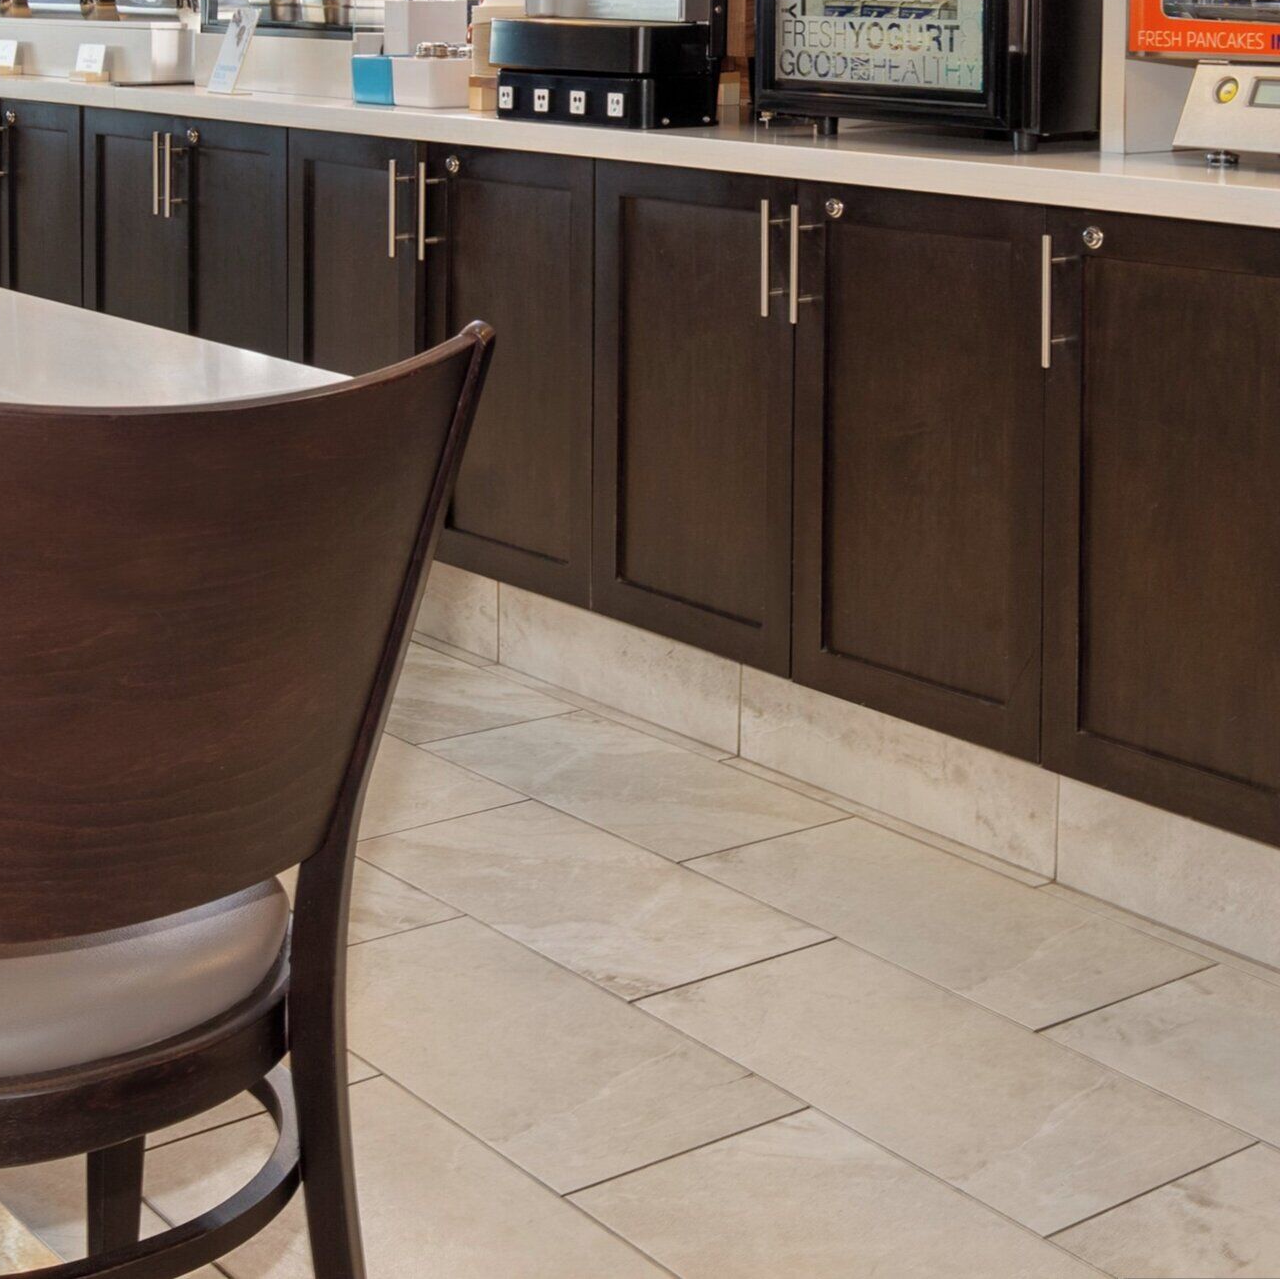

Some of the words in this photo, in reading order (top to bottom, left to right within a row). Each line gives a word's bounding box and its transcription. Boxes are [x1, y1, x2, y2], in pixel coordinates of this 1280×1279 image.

[782, 20, 847, 49] FRESH
[848, 22, 961, 53] YOGURT
[1137, 29, 1182, 49] FRESH
[1186, 31, 1265, 52] PANCAKES
[779, 48, 849, 79] GOOD
[872, 55, 978, 87] HEALTHY
